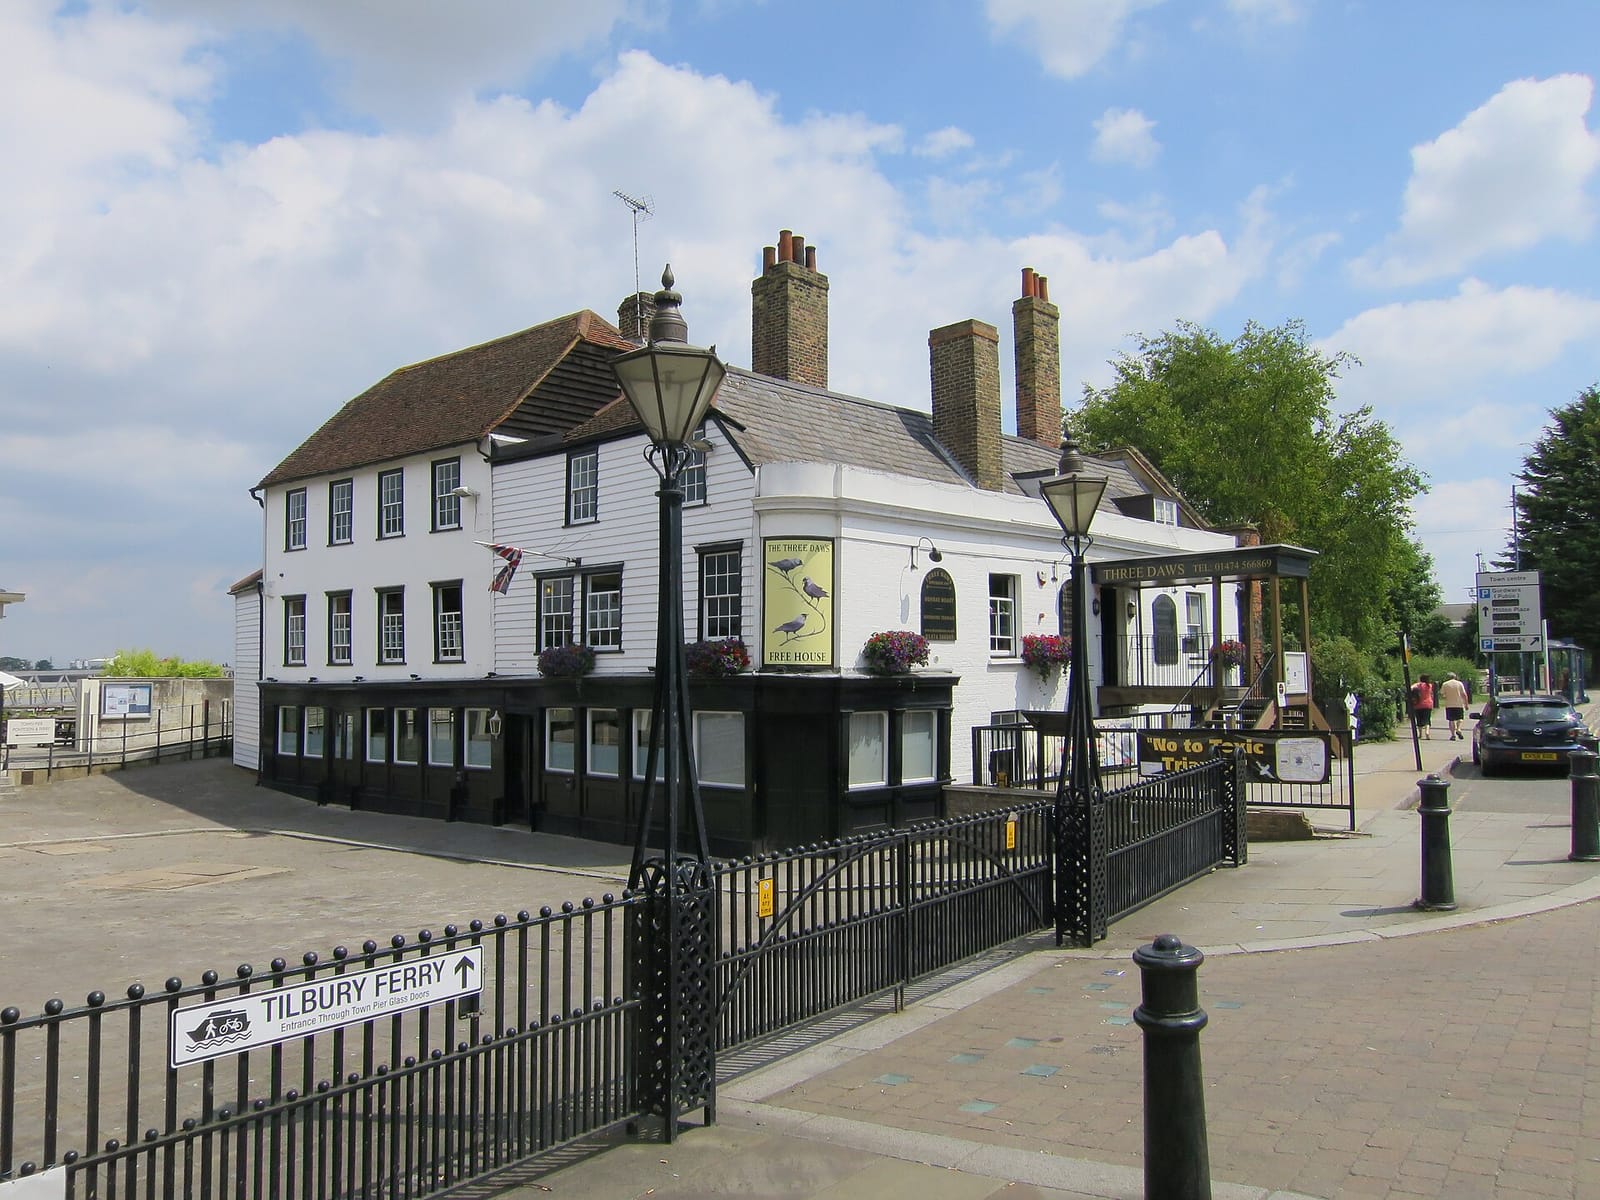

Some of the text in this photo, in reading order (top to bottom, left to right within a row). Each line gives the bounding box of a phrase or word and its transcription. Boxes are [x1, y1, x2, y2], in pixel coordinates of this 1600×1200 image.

[767, 543, 831, 553] THE THREE DAWS
[1103, 566, 1145, 581] THREE
[1147, 562, 1185, 578] DAWS
[1214, 560, 1240, 572] 01474
[1241, 558, 1273, 570] 566869
[769, 651, 827, 662] FREE HOUSE
[1183, 739, 1204, 753] to
[261, 959, 445, 1023] TILBURY FERRY
[280, 988, 431, 1033] Entrance Through Town Pier Glass Doors
